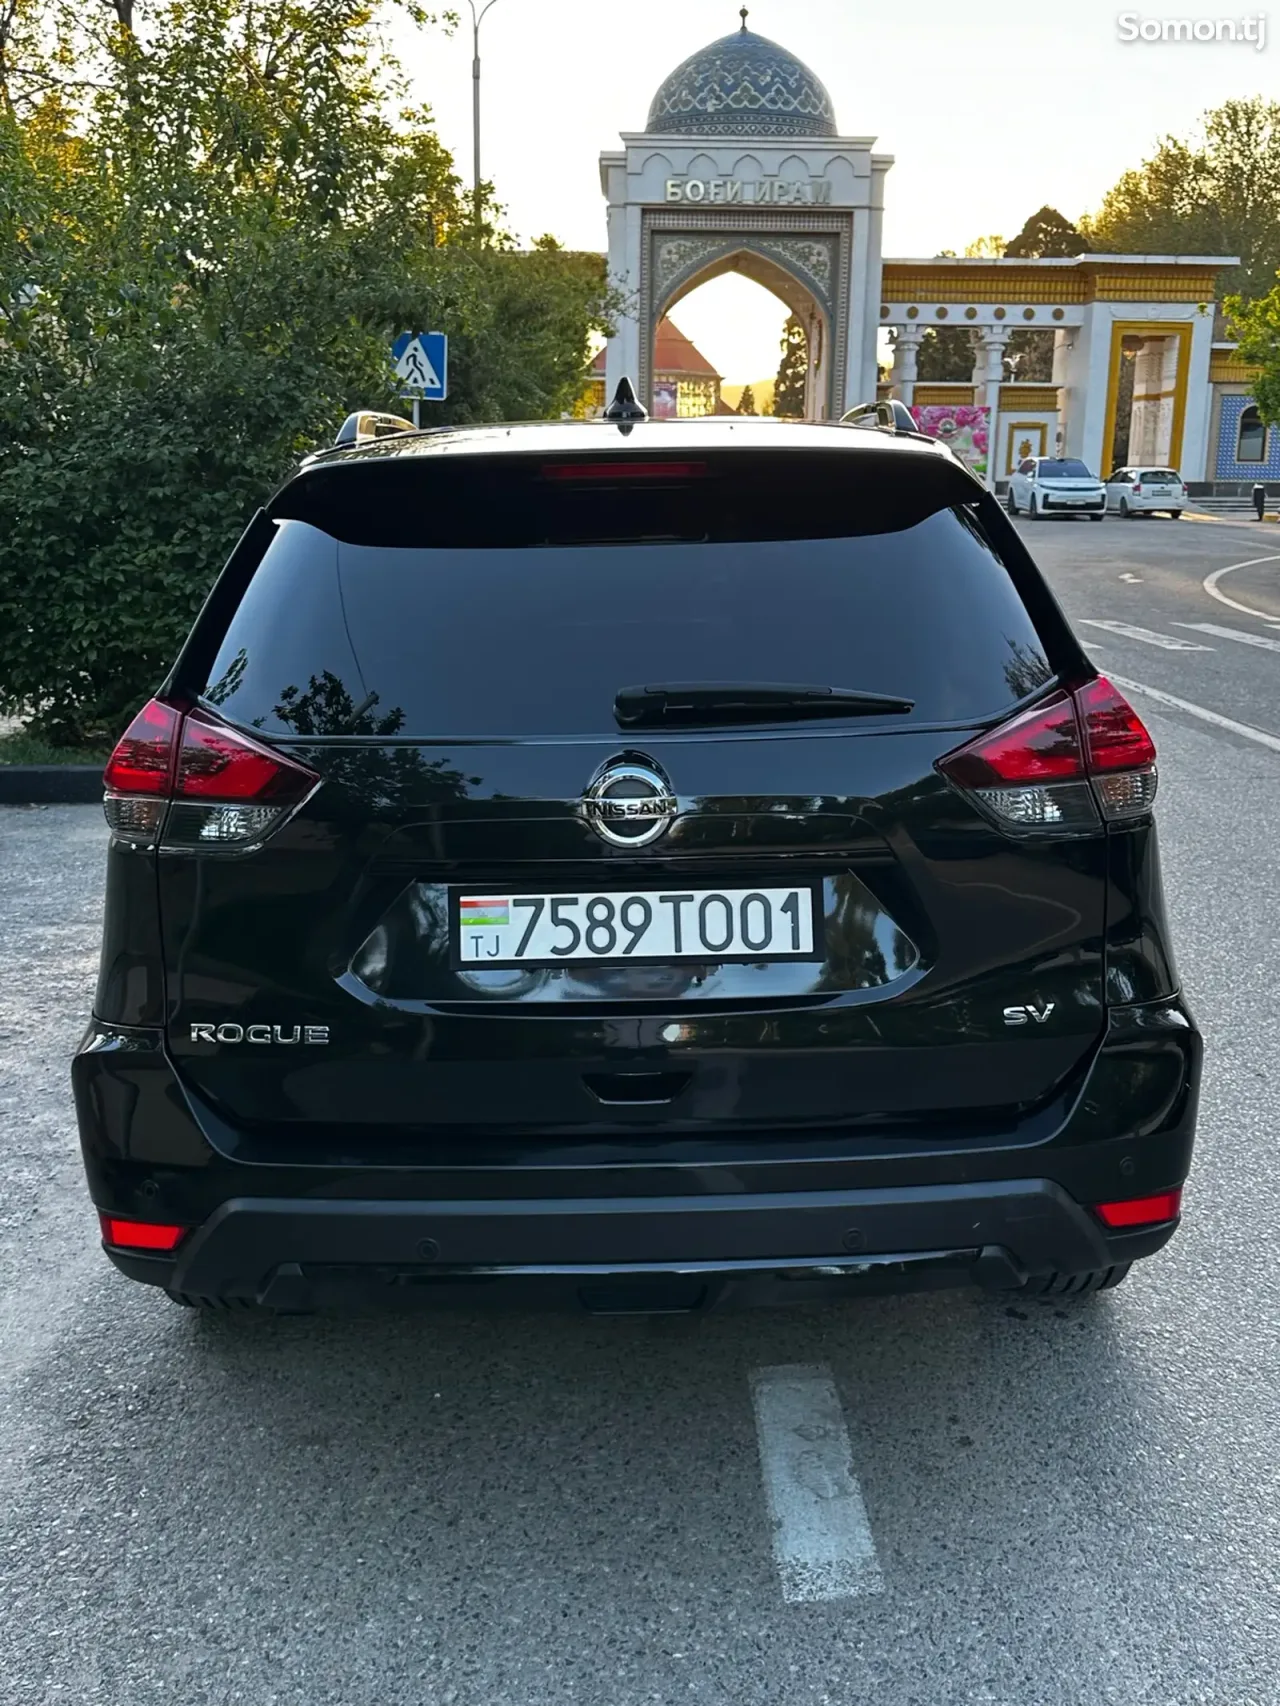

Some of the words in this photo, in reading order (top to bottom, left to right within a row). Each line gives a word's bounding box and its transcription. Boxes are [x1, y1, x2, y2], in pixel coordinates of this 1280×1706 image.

[755, 180, 831, 204] ИРАМ
[587, 799, 667, 816] NISSAN
[470, 935, 500, 958] TJ
[1003, 1003, 1055, 1026] SV
[190, 1023, 330, 1045] ROGUE
